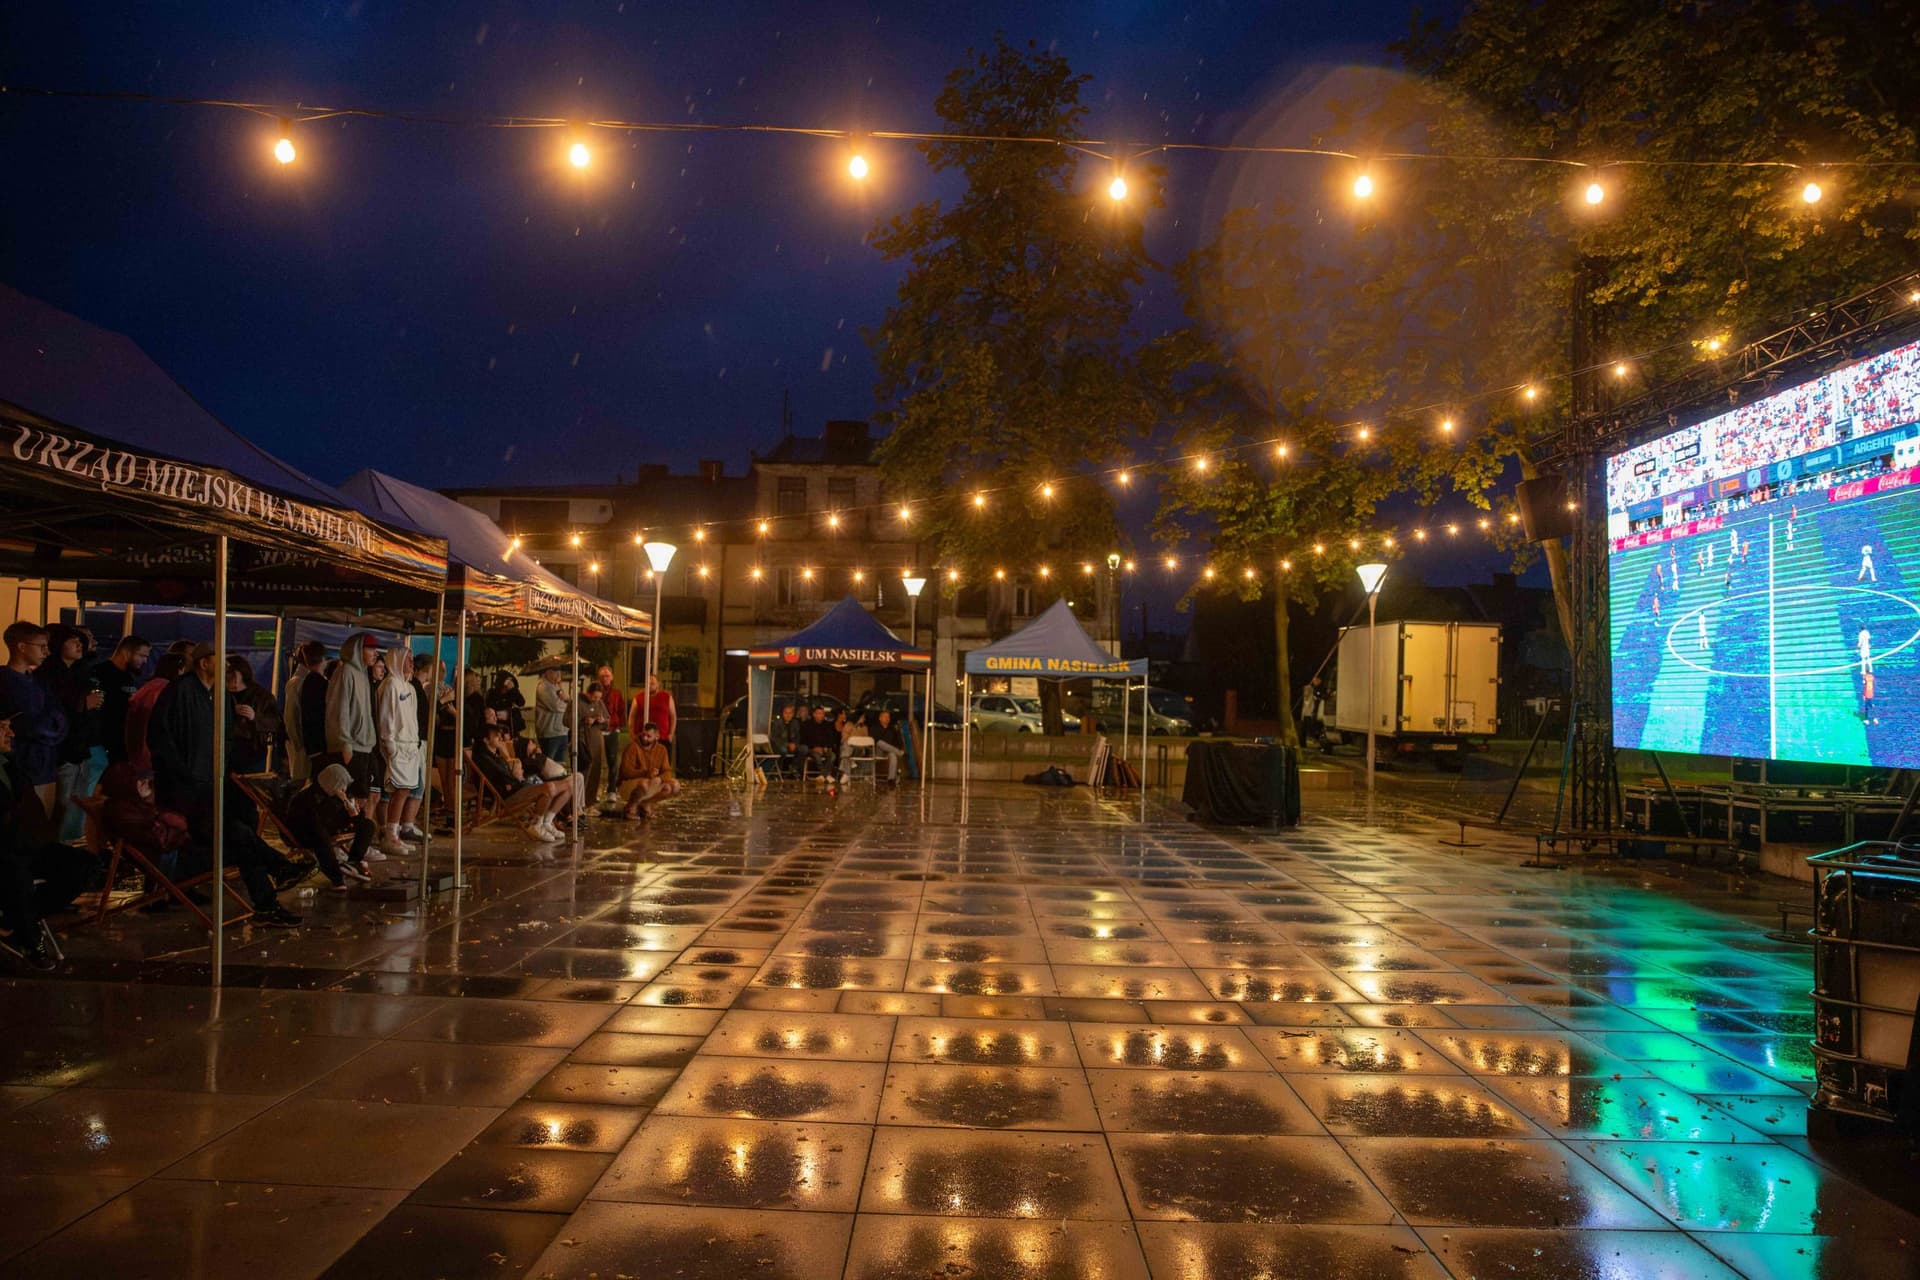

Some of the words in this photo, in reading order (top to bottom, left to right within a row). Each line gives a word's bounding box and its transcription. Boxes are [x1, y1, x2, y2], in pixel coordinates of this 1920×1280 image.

[1854, 430, 1906, 455] ARGENTINA
[13, 425, 136, 491] URZĄD
[141, 459, 252, 515] MIEJSKI
[259, 490, 280, 525] W
[281, 499, 378, 553] NASIELSKU
[805, 648, 827, 660] UM
[830, 648, 897, 662] NASIELSK
[985, 656, 1043, 671] GMINA
[1047, 657, 1131, 673] NASIELSK
